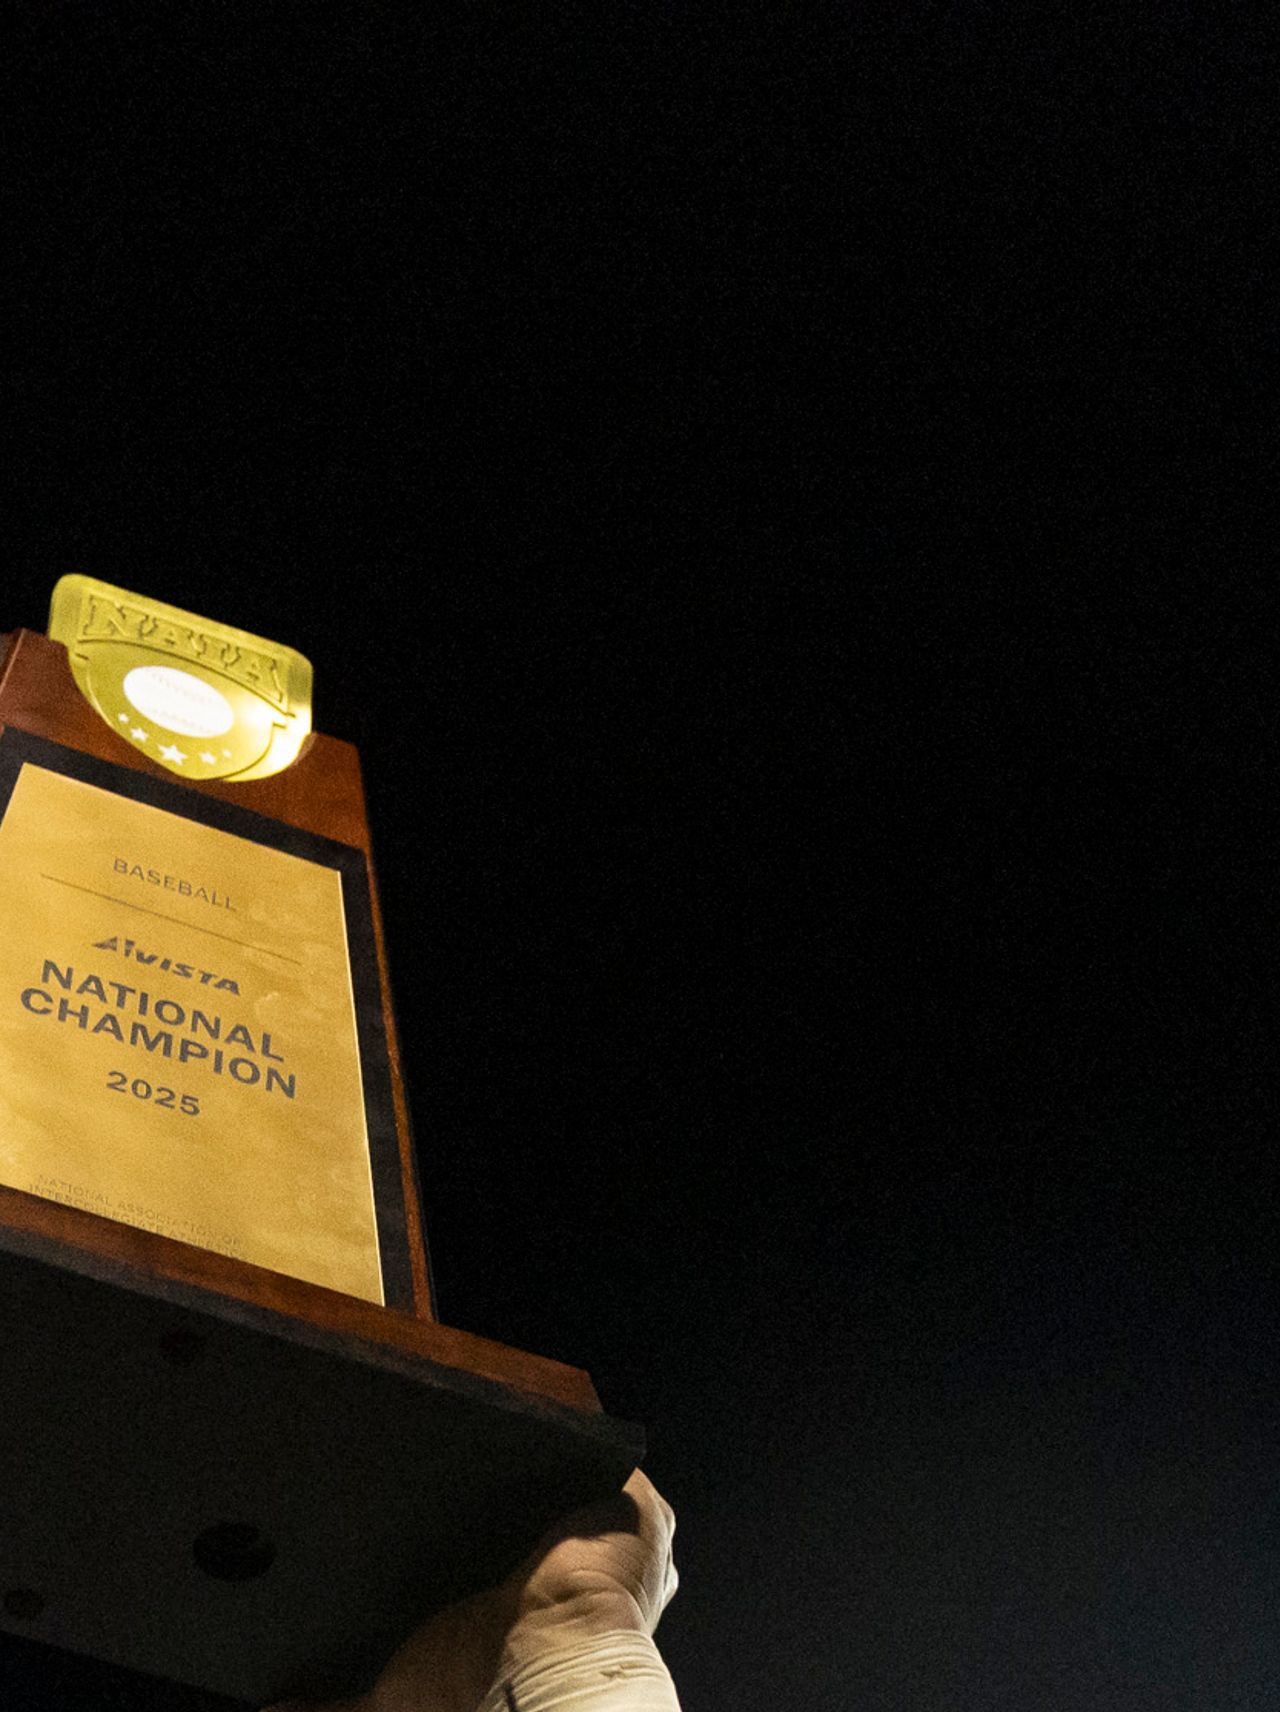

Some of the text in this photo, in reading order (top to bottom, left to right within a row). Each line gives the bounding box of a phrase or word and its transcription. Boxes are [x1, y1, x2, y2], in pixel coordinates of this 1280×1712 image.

[83, 594, 284, 704] NAIA
[113, 858, 238, 912] BASEBALL
[20, 986, 297, 1101] CHAMPION
[40, 958, 285, 1063] NATIONAL
[106, 1070, 201, 1117] 2025
